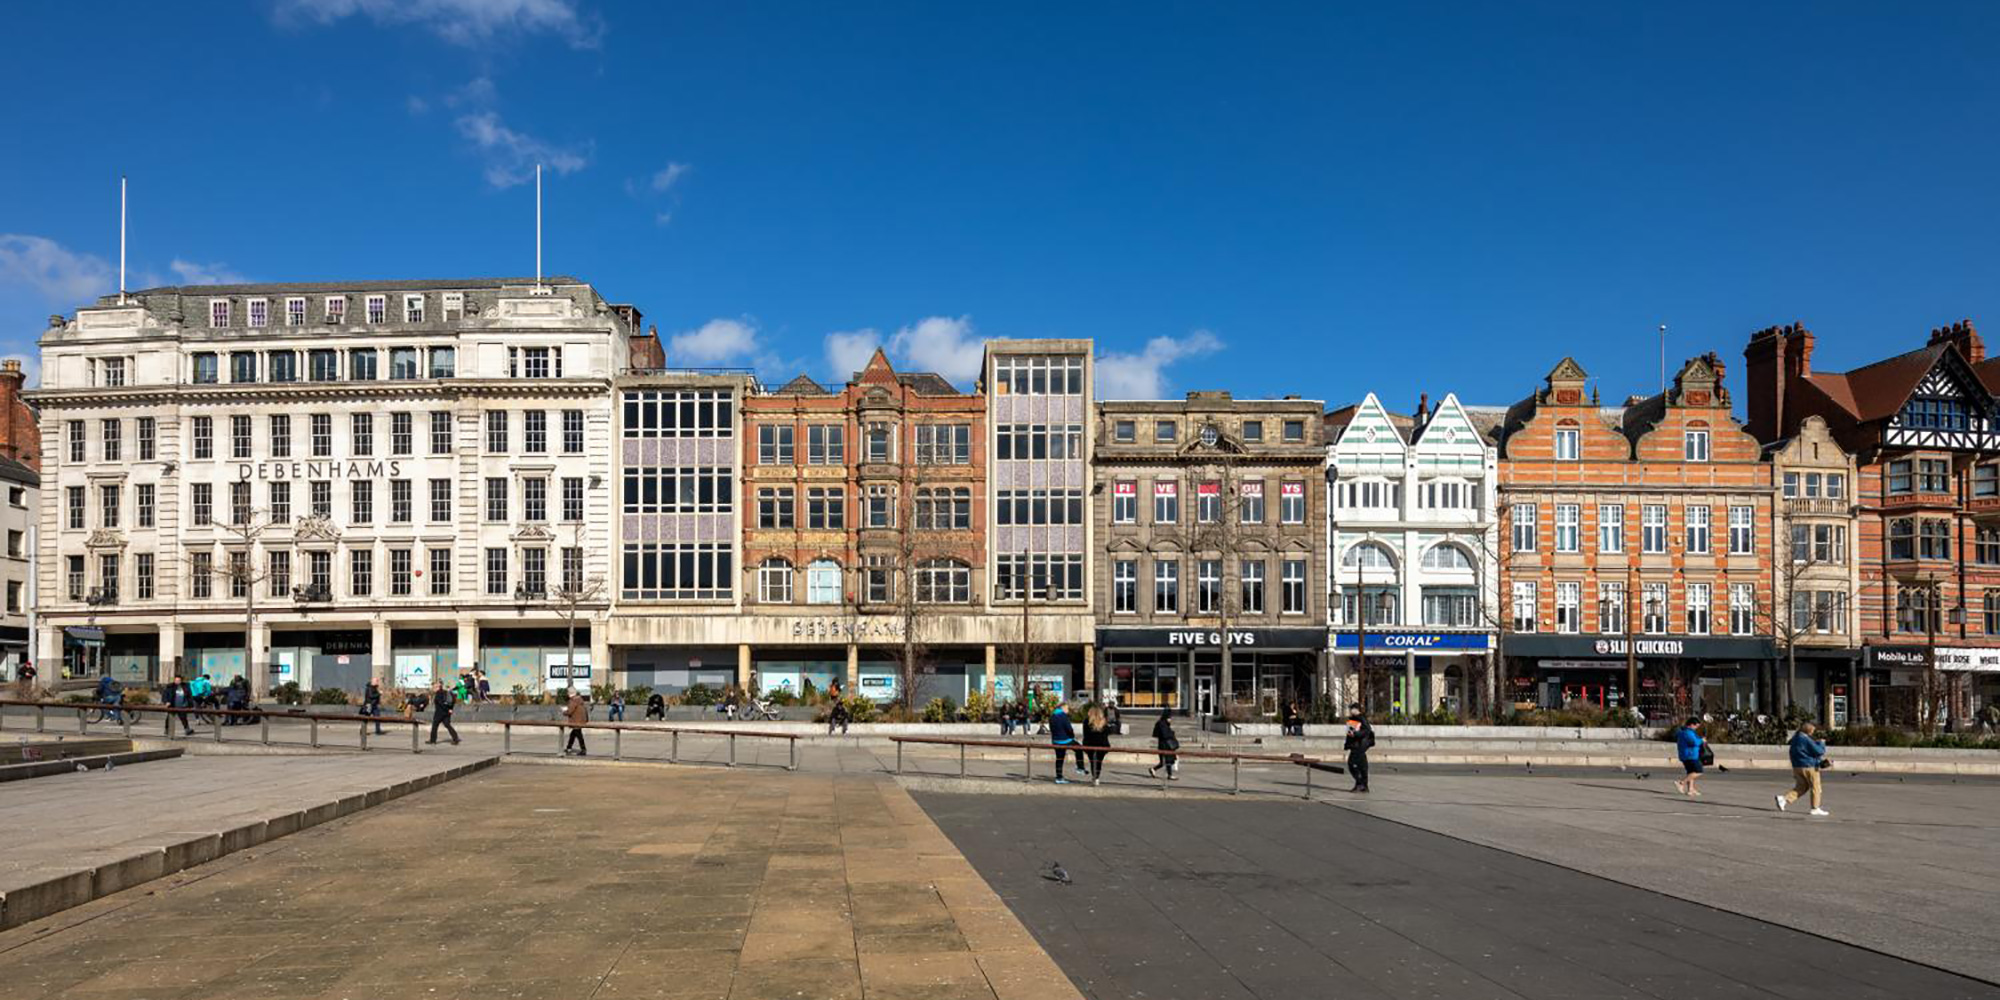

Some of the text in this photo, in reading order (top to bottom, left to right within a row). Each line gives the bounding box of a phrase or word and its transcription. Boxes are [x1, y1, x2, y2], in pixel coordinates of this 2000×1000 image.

[239, 461, 400, 479] DEBENHAMS
[1119, 483, 1301, 493] FI VE GU YS
[1169, 632, 1205, 644] FIVE
[1385, 635, 1433, 646] CORAL
[1636, 640, 1684, 654] CHICKENS
[1878, 651, 1906, 661] Mobile
